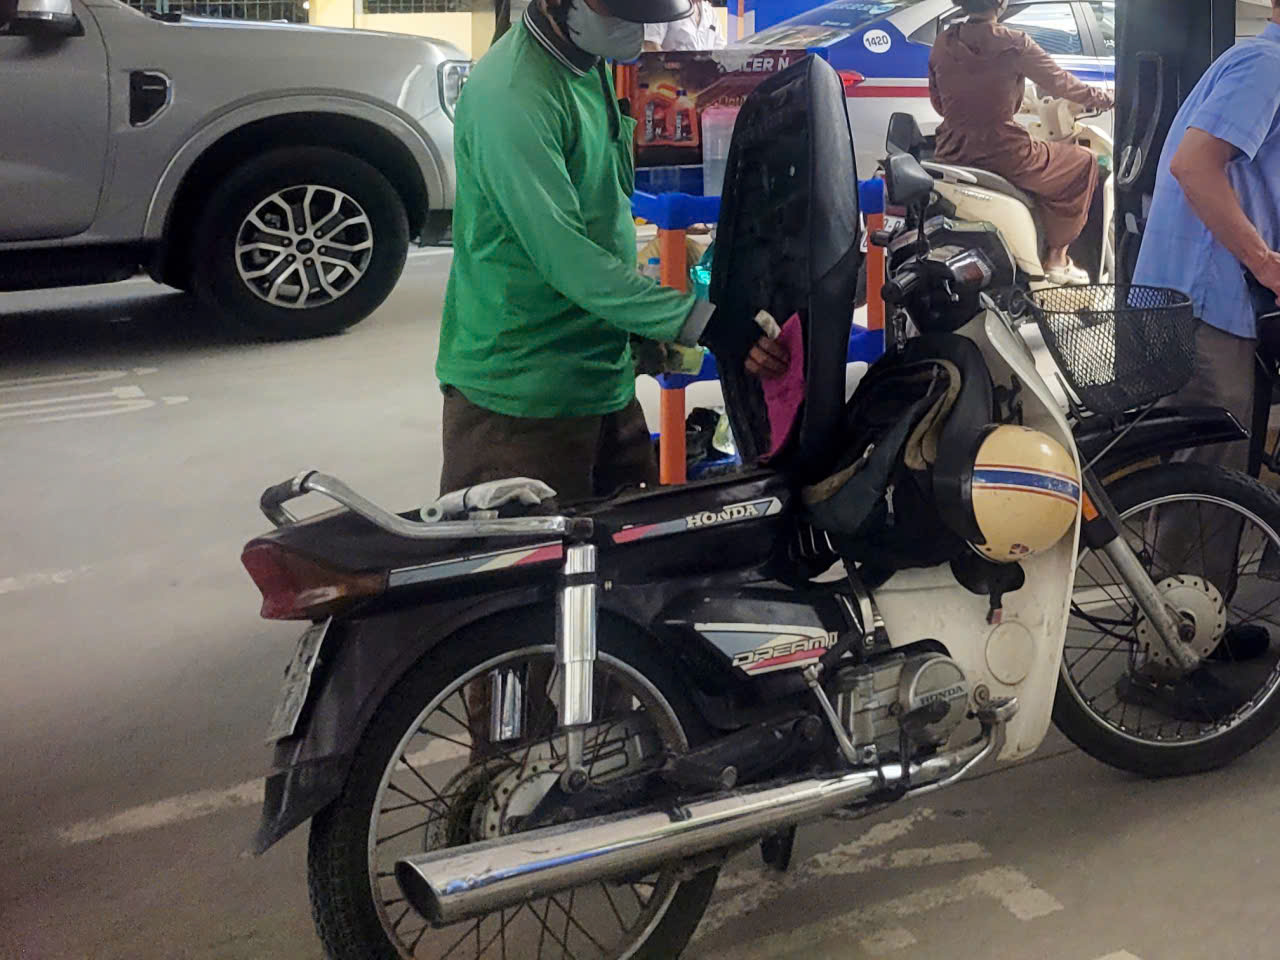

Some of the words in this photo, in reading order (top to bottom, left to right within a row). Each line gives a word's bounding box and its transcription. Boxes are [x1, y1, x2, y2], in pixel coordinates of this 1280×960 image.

[865, 34, 889, 48] 1420
[686, 503, 760, 529] HONDA
[732, 636, 828, 667] DREAM
[919, 685, 965, 705] HONDA
